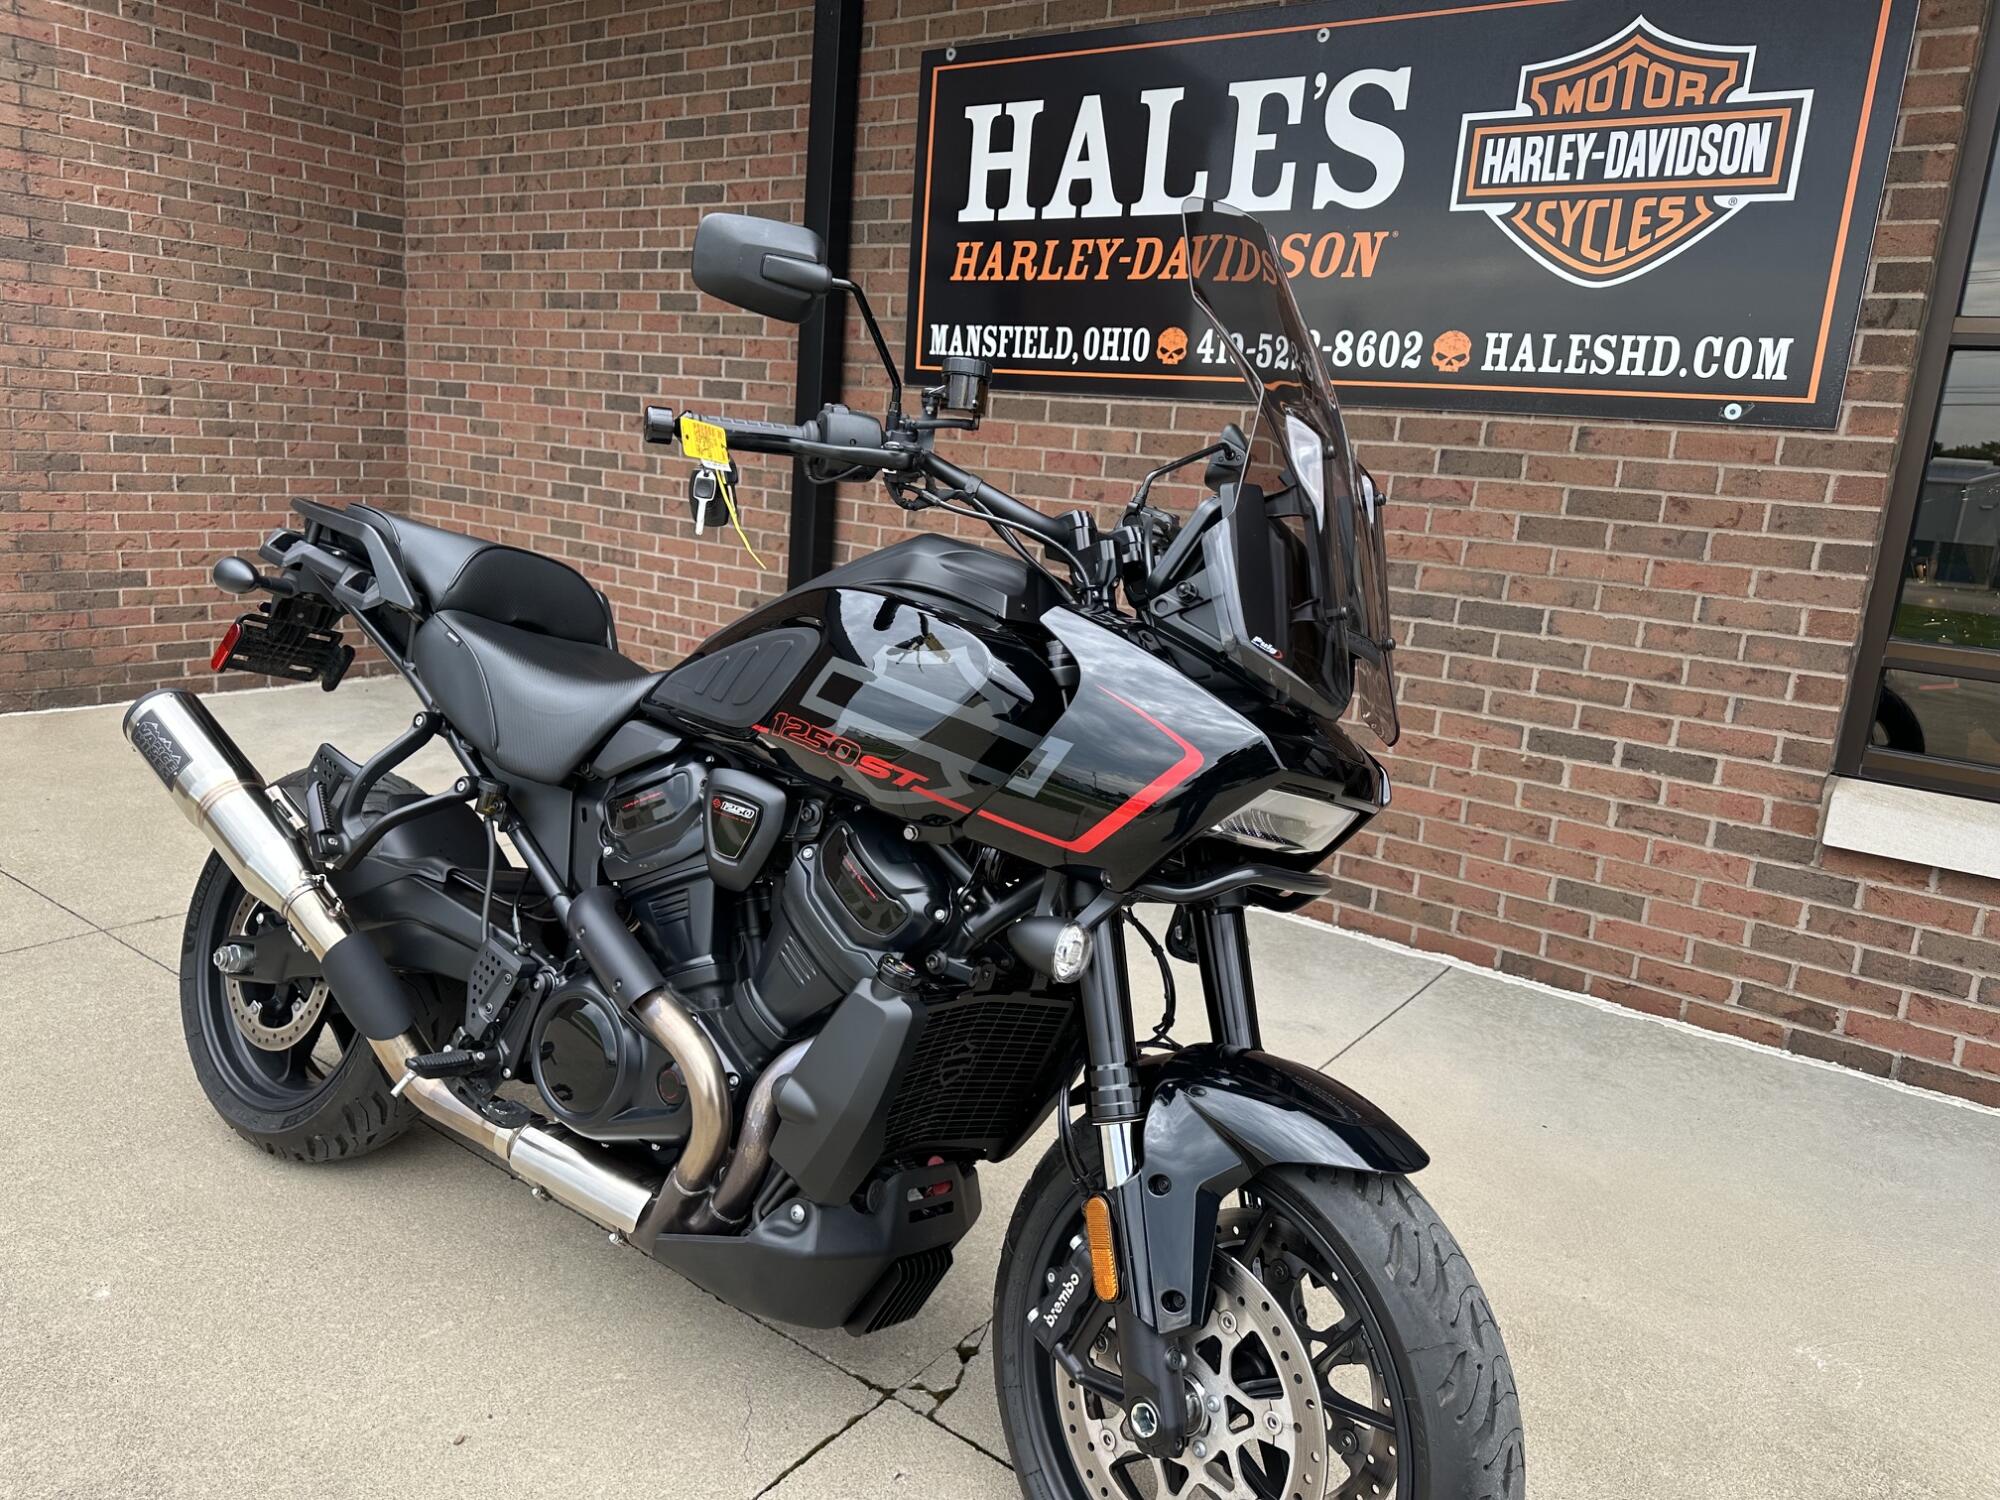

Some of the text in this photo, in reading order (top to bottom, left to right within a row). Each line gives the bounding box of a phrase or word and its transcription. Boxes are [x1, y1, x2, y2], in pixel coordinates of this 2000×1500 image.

[1553, 51, 1708, 115] MOTOR
[957, 66, 1412, 222] HALE'S
[1480, 121, 1772, 185] HARLEY-DAVIDSON
[949, 231, 1389, 282] HARLEY-DAVIDSON
[1535, 195, 1686, 262] CYCLES
[1481, 330, 1795, 381] HALESHD.COM
[1043, 1273, 1080, 1329] brembo
